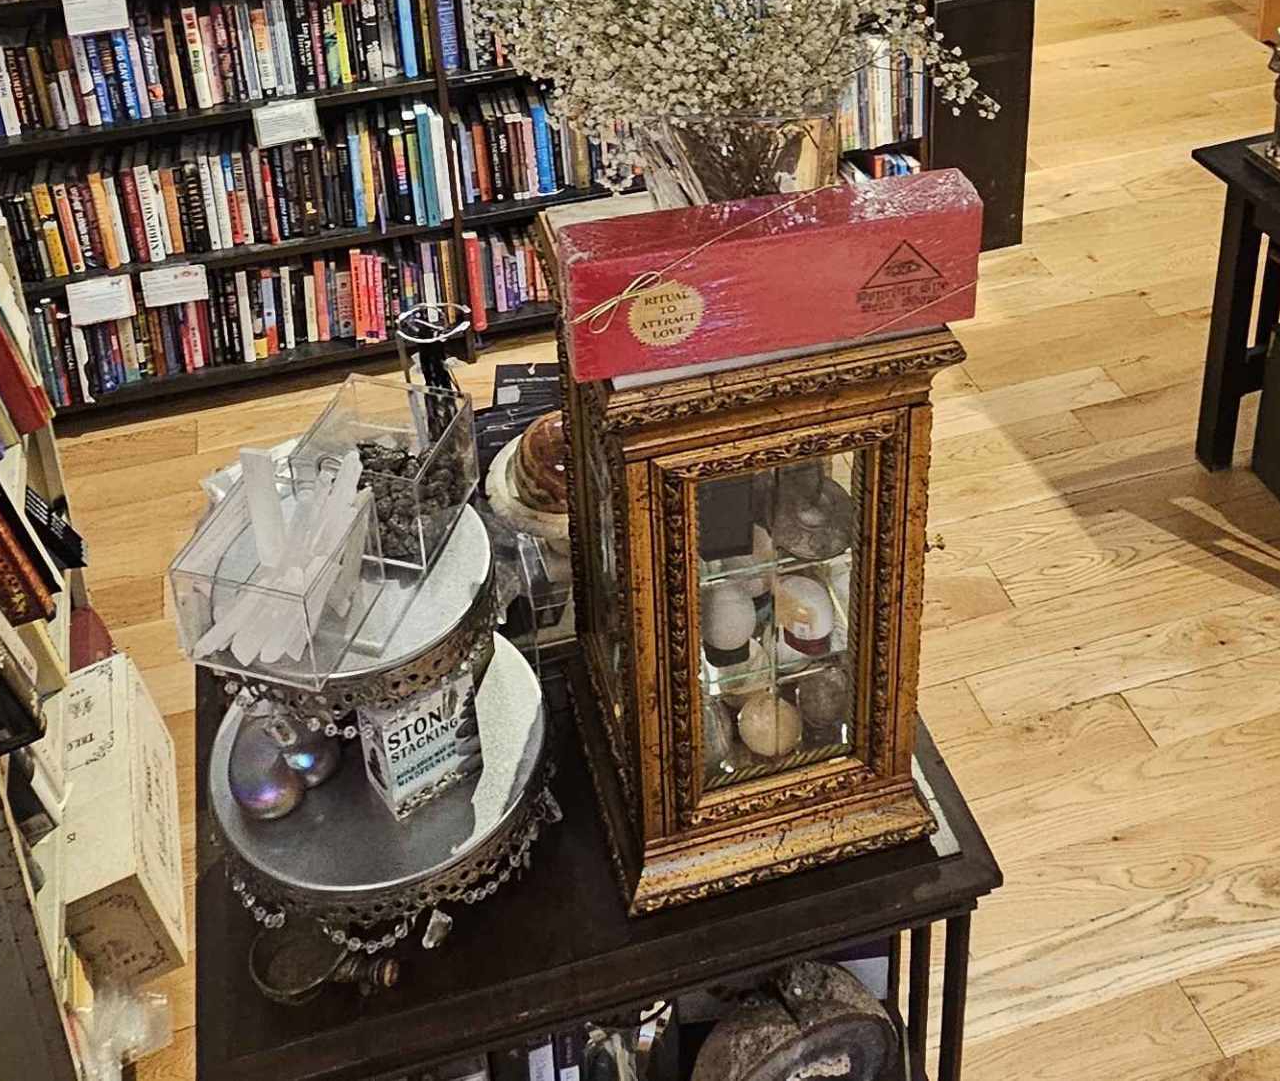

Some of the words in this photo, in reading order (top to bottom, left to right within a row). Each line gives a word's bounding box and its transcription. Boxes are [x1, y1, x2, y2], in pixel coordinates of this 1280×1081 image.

[5, 49, 24, 99] RECLAIMED
[146, 221, 161, 250] JOHN
[644, 290, 690, 306] RITUAL
[640, 312, 697, 330] ATTRACT
[661, 305, 677, 315] TO
[652, 326, 685, 339] LOVE
[388, 705, 442, 752] STON
[390, 717, 458, 764] STACKING
